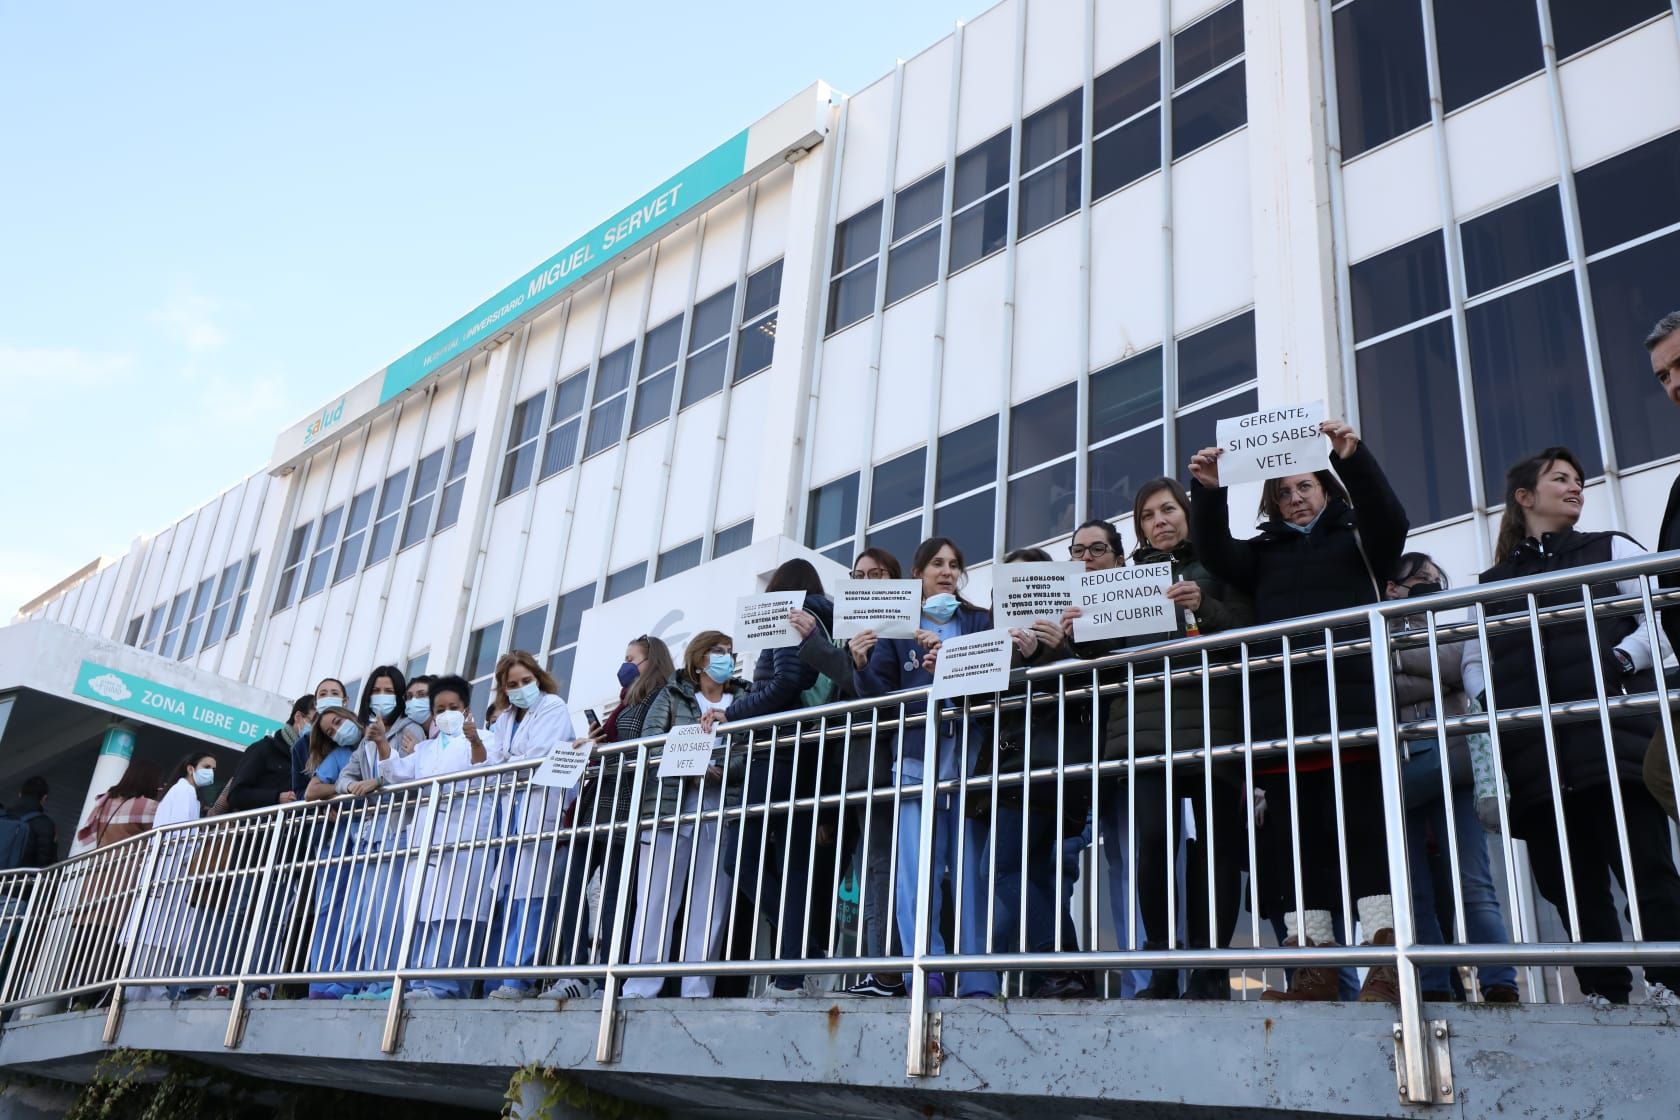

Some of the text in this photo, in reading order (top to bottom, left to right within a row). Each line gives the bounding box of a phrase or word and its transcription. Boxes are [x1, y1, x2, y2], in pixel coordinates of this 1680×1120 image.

[462, 294, 525, 342] UNIVERSITARIO
[527, 243, 596, 299] MIGUEL
[602, 183, 683, 250] SERVET
[303, 398, 346, 445] salud
[1240, 407, 1309, 428] GERENTE,
[1229, 425, 1321, 452] SI NO SABES,
[1256, 452, 1297, 469] VETE.
[1081, 565, 1170, 587] REDUCCIONES
[1082, 585, 1162, 606] DE JORNADA
[1093, 605, 1164, 624] SIN CUBRIR
[141, 690, 259, 738] ZONA LIBRE DE
[679, 726, 705, 736] GERENT
[670, 744, 676, 752] SI
[678, 743, 688, 752] NO
